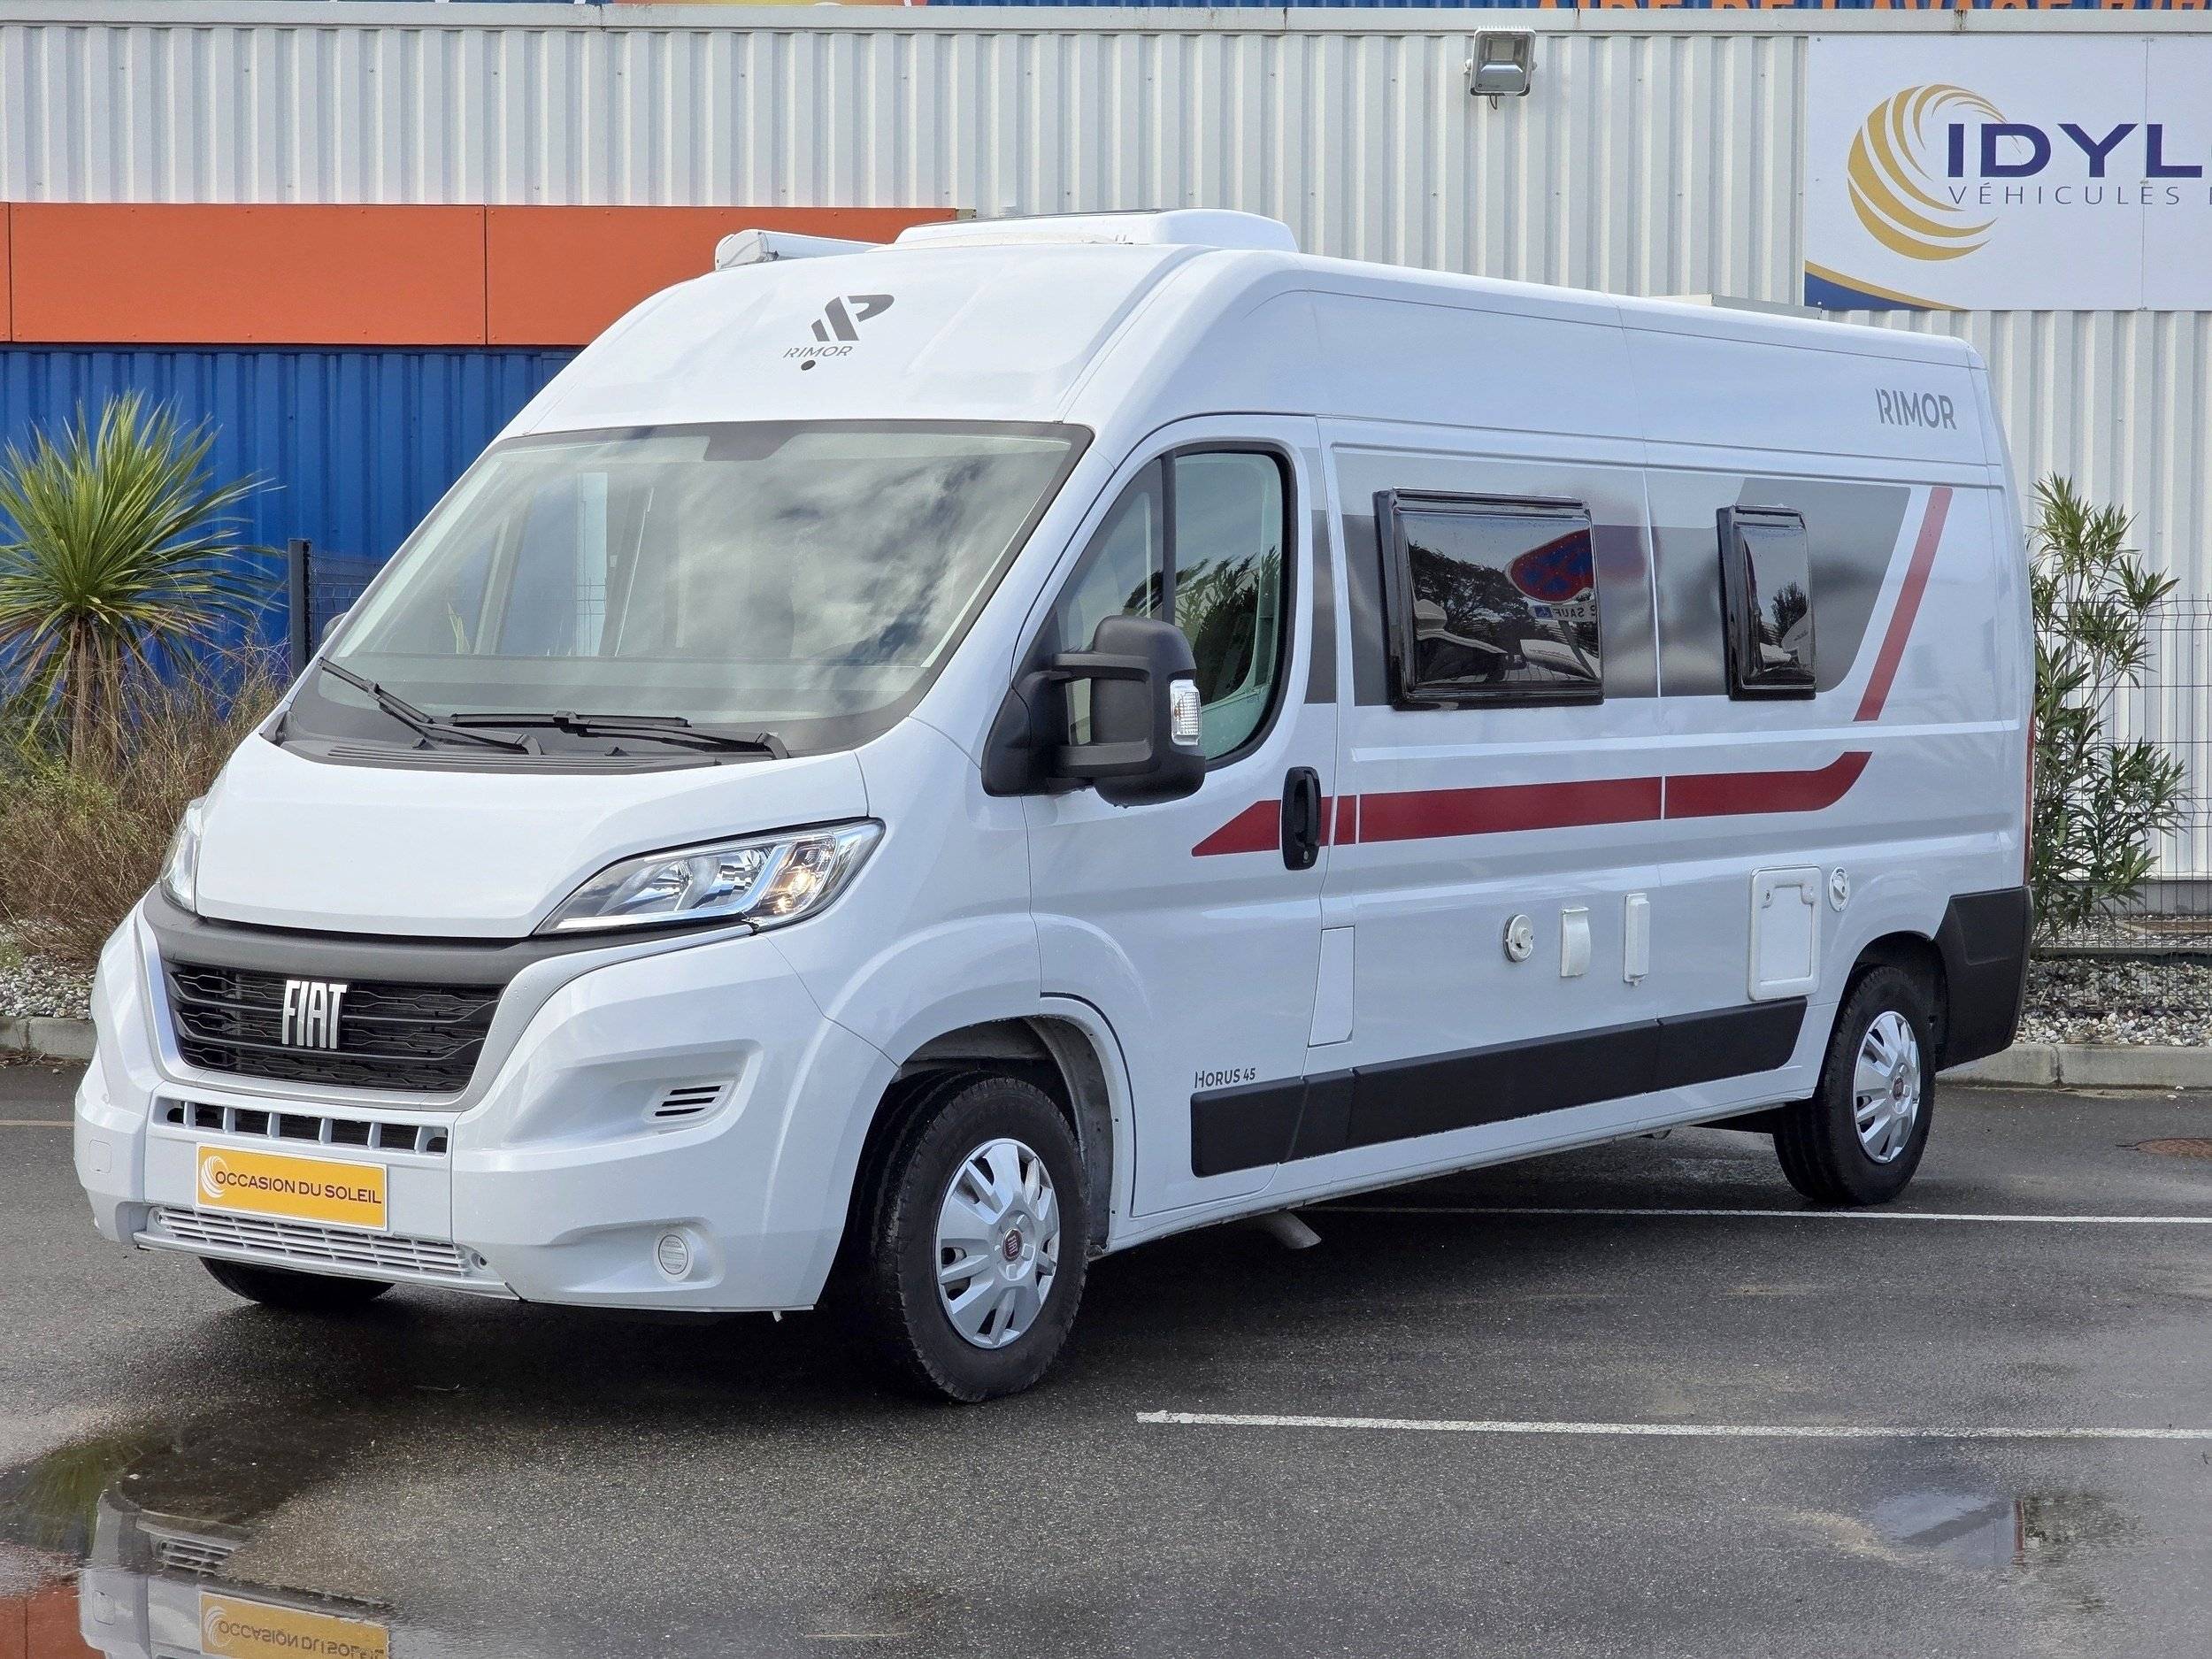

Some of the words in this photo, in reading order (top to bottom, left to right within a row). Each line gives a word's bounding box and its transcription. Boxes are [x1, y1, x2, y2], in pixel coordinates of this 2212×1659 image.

[1947, 123, 2212, 178] IDYL
[1948, 181, 2180, 205] VÉHICULES
[783, 345, 853, 358] RIMOR
[1875, 388, 1957, 430] RIMOR
[281, 979, 348, 1048] FIAT
[1194, 1068, 1240, 1088] HORUS
[1242, 1067, 1256, 1080] 45
[215, 1171, 296, 1194] OCCASION
[298, 1181, 321, 1197] DU
[324, 1184, 382, 1204] SOLEIL
